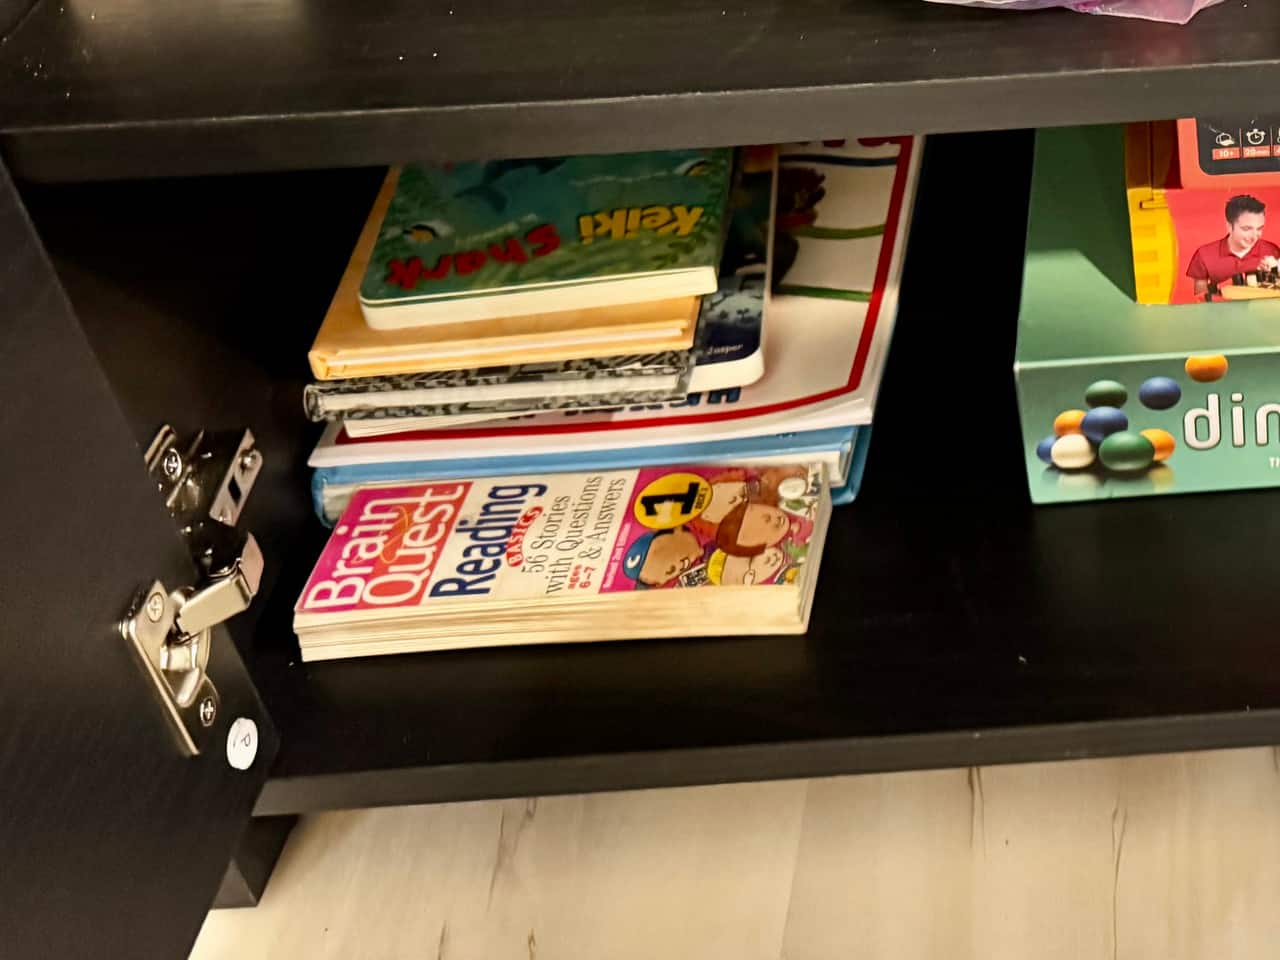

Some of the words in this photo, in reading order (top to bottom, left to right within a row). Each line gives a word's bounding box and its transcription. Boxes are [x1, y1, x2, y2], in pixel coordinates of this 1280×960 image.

[579, 204, 704, 245] Keiki
[531, 495, 571, 550] Stories
[556, 475, 604, 552] Questions
[586, 477, 626, 542] Answers
[641, 482, 700, 517] 1
[303, 496, 405, 609] Brain
[361, 485, 465, 605] Quest
[429, 483, 548, 598] Reading
[508, 507, 541, 565] BASICS
[521, 553, 549, 573] 56
[578, 546, 602, 560] &
[545, 556, 574, 594] with
